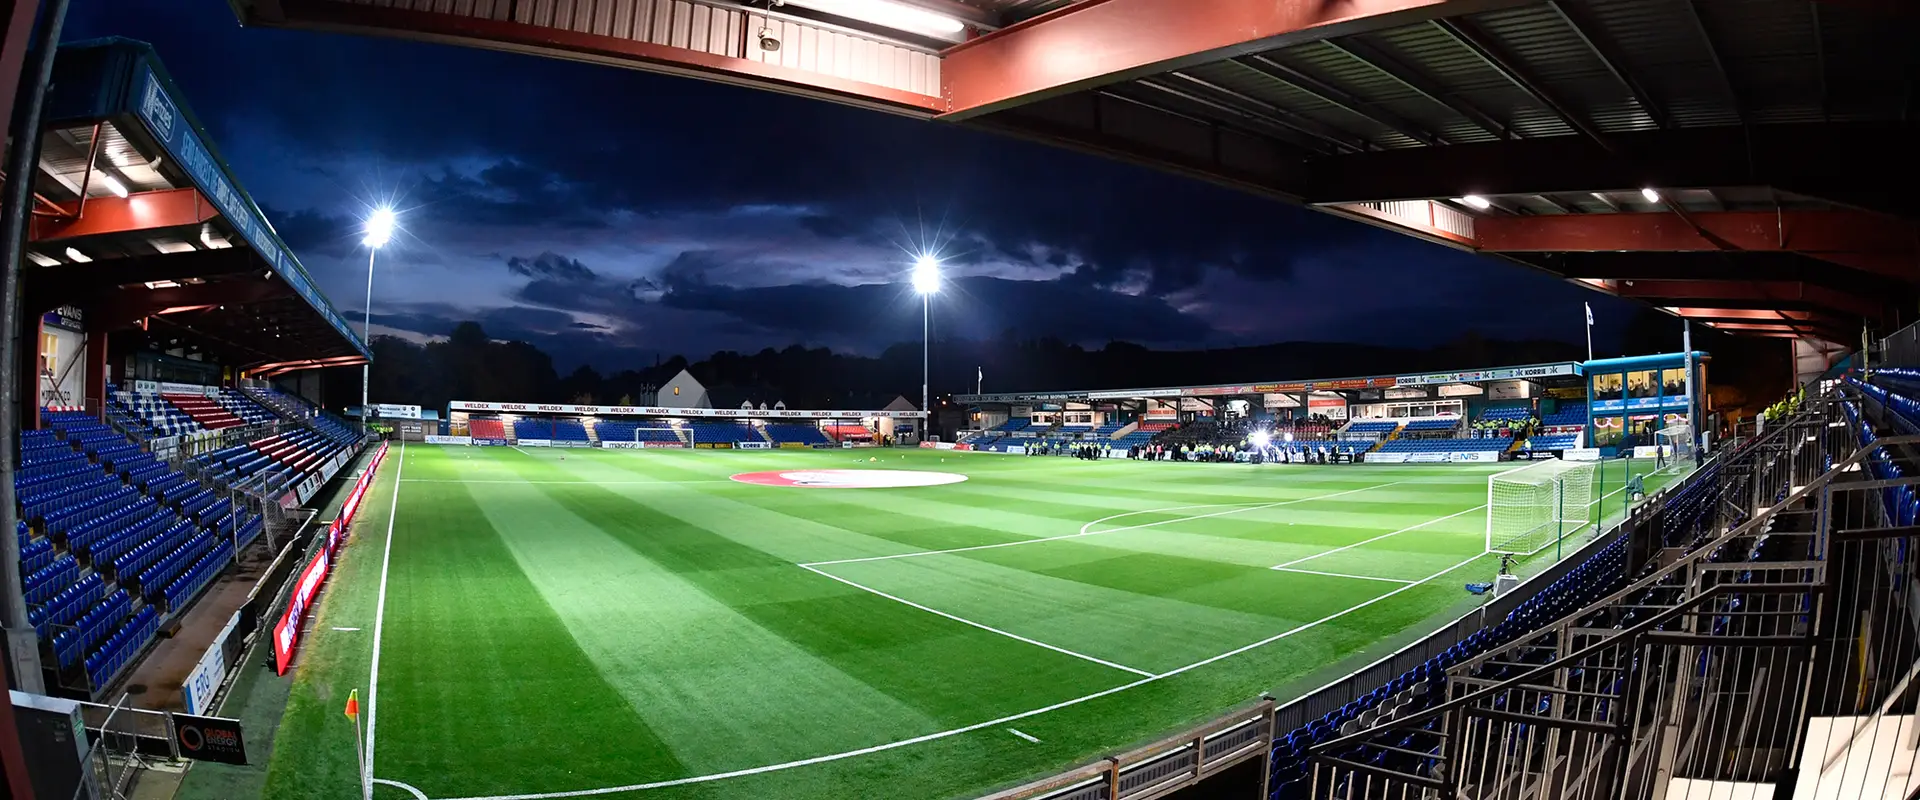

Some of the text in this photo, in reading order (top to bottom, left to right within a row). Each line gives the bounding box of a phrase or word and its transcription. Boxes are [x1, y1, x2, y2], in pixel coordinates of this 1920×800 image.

[1460, 452, 1479, 460] NTS
[195, 666, 210, 702] ERG
[204, 727, 237, 741] GLOBAL
[206, 732, 238, 747] ENERGY
